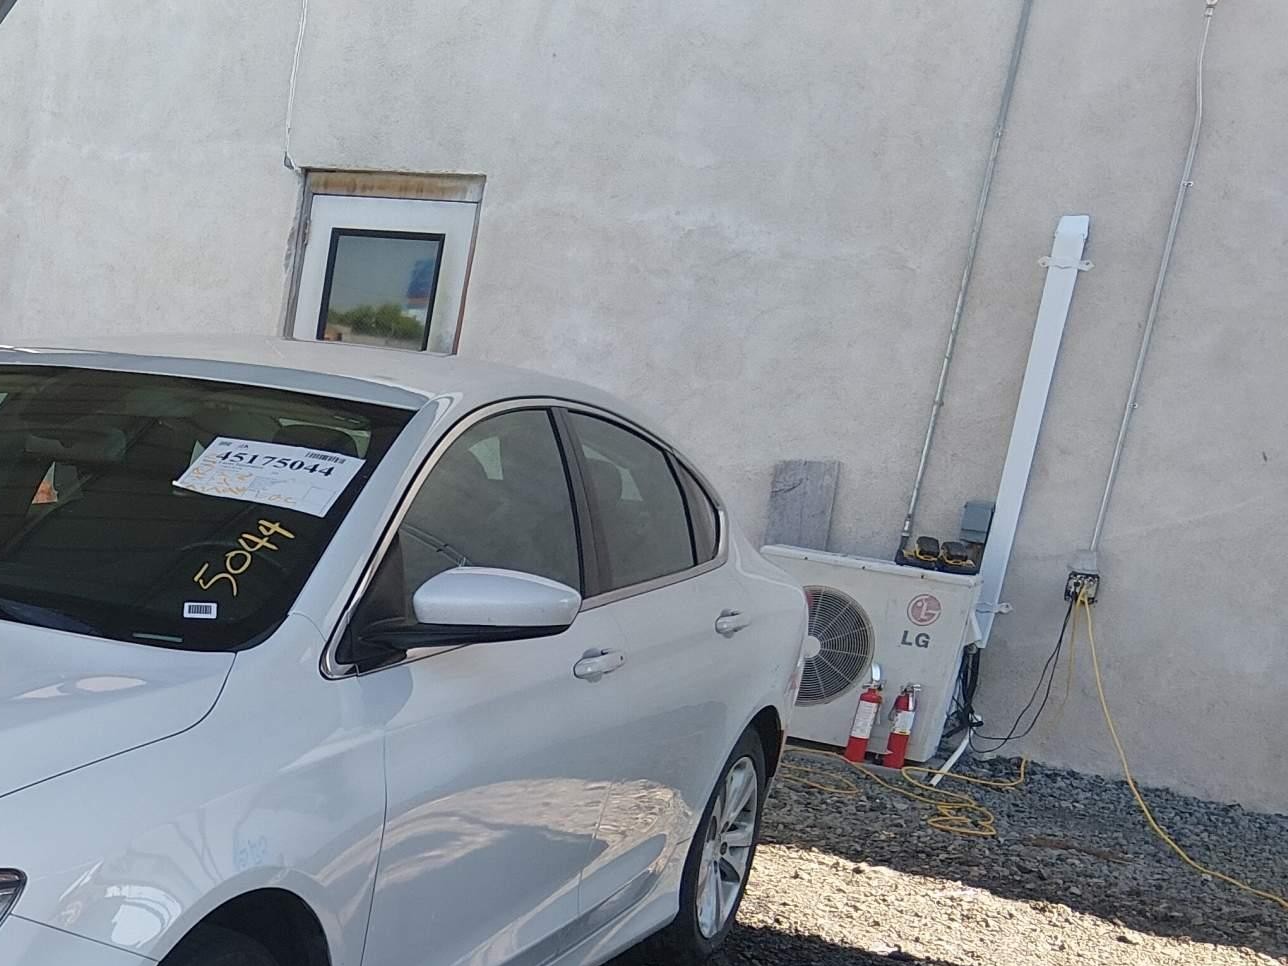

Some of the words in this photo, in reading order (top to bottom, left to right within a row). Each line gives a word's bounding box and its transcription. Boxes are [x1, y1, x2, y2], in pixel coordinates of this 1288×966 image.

[215, 450, 335, 477] 45175044
[194, 519, 295, 597] 5044
[900, 630, 931, 649] LG
